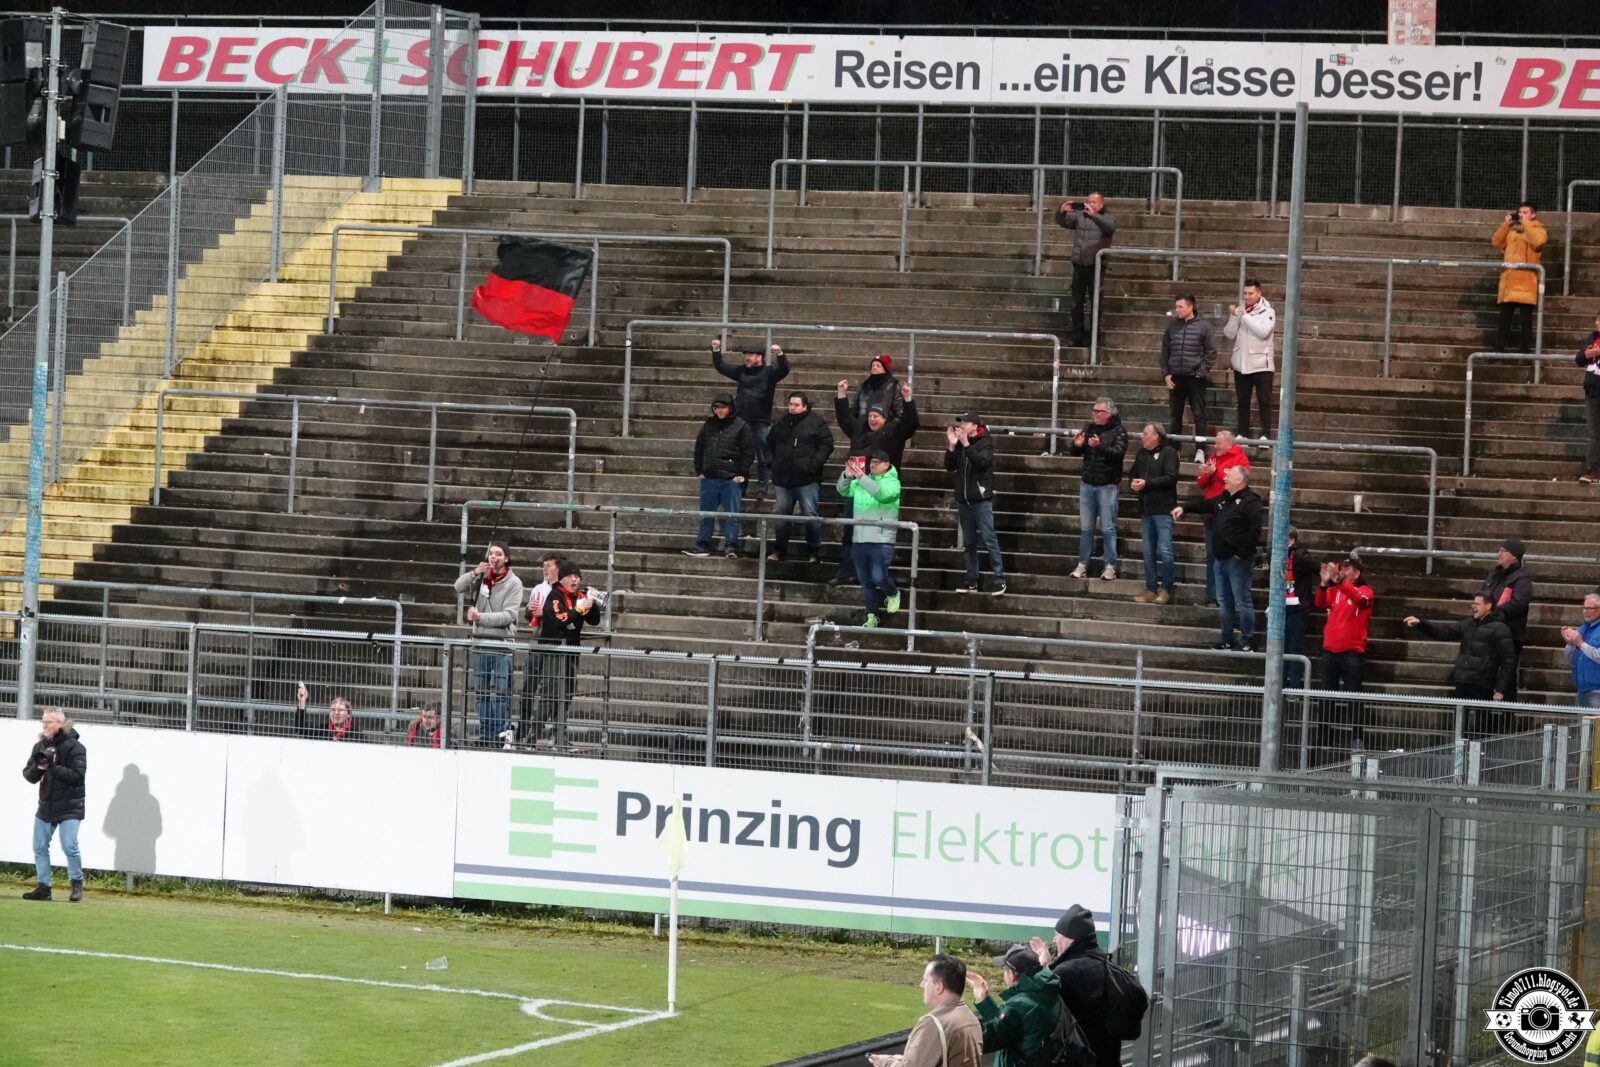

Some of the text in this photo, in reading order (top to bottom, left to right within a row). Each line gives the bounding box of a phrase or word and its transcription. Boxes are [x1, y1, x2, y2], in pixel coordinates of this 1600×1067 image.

[834, 49, 981, 90] Reisen
[1144, 55, 1296, 97] Klasse
[1314, 58, 1483, 102] besser!
[1499, 58, 1600, 109] BE
[616, 791, 861, 868] Prinzing
